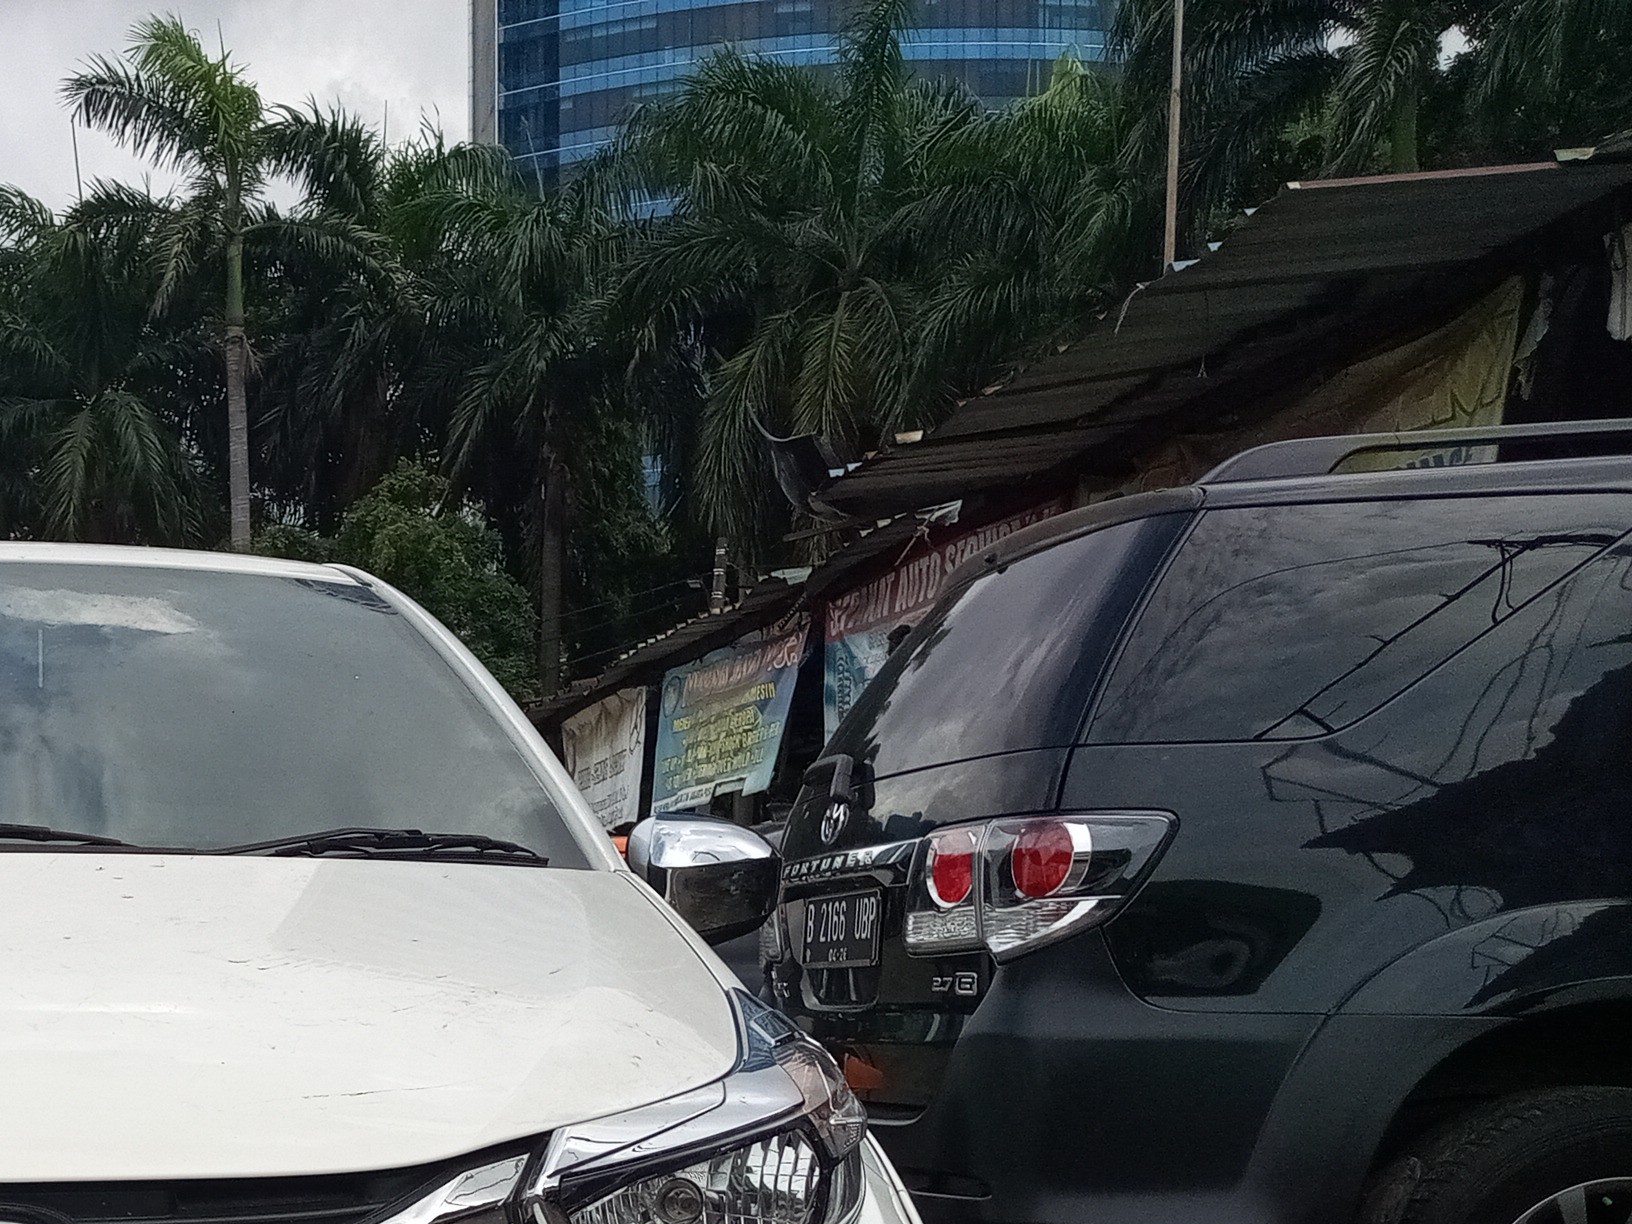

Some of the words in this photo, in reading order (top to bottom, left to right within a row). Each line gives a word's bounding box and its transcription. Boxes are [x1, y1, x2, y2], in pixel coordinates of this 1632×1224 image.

[895, 552, 941, 613] AUTO
[782, 851, 873, 878] FORTUNER
[806, 904, 815, 943] B
[819, 901, 846, 943] 2166
[854, 896, 877, 940] UBP
